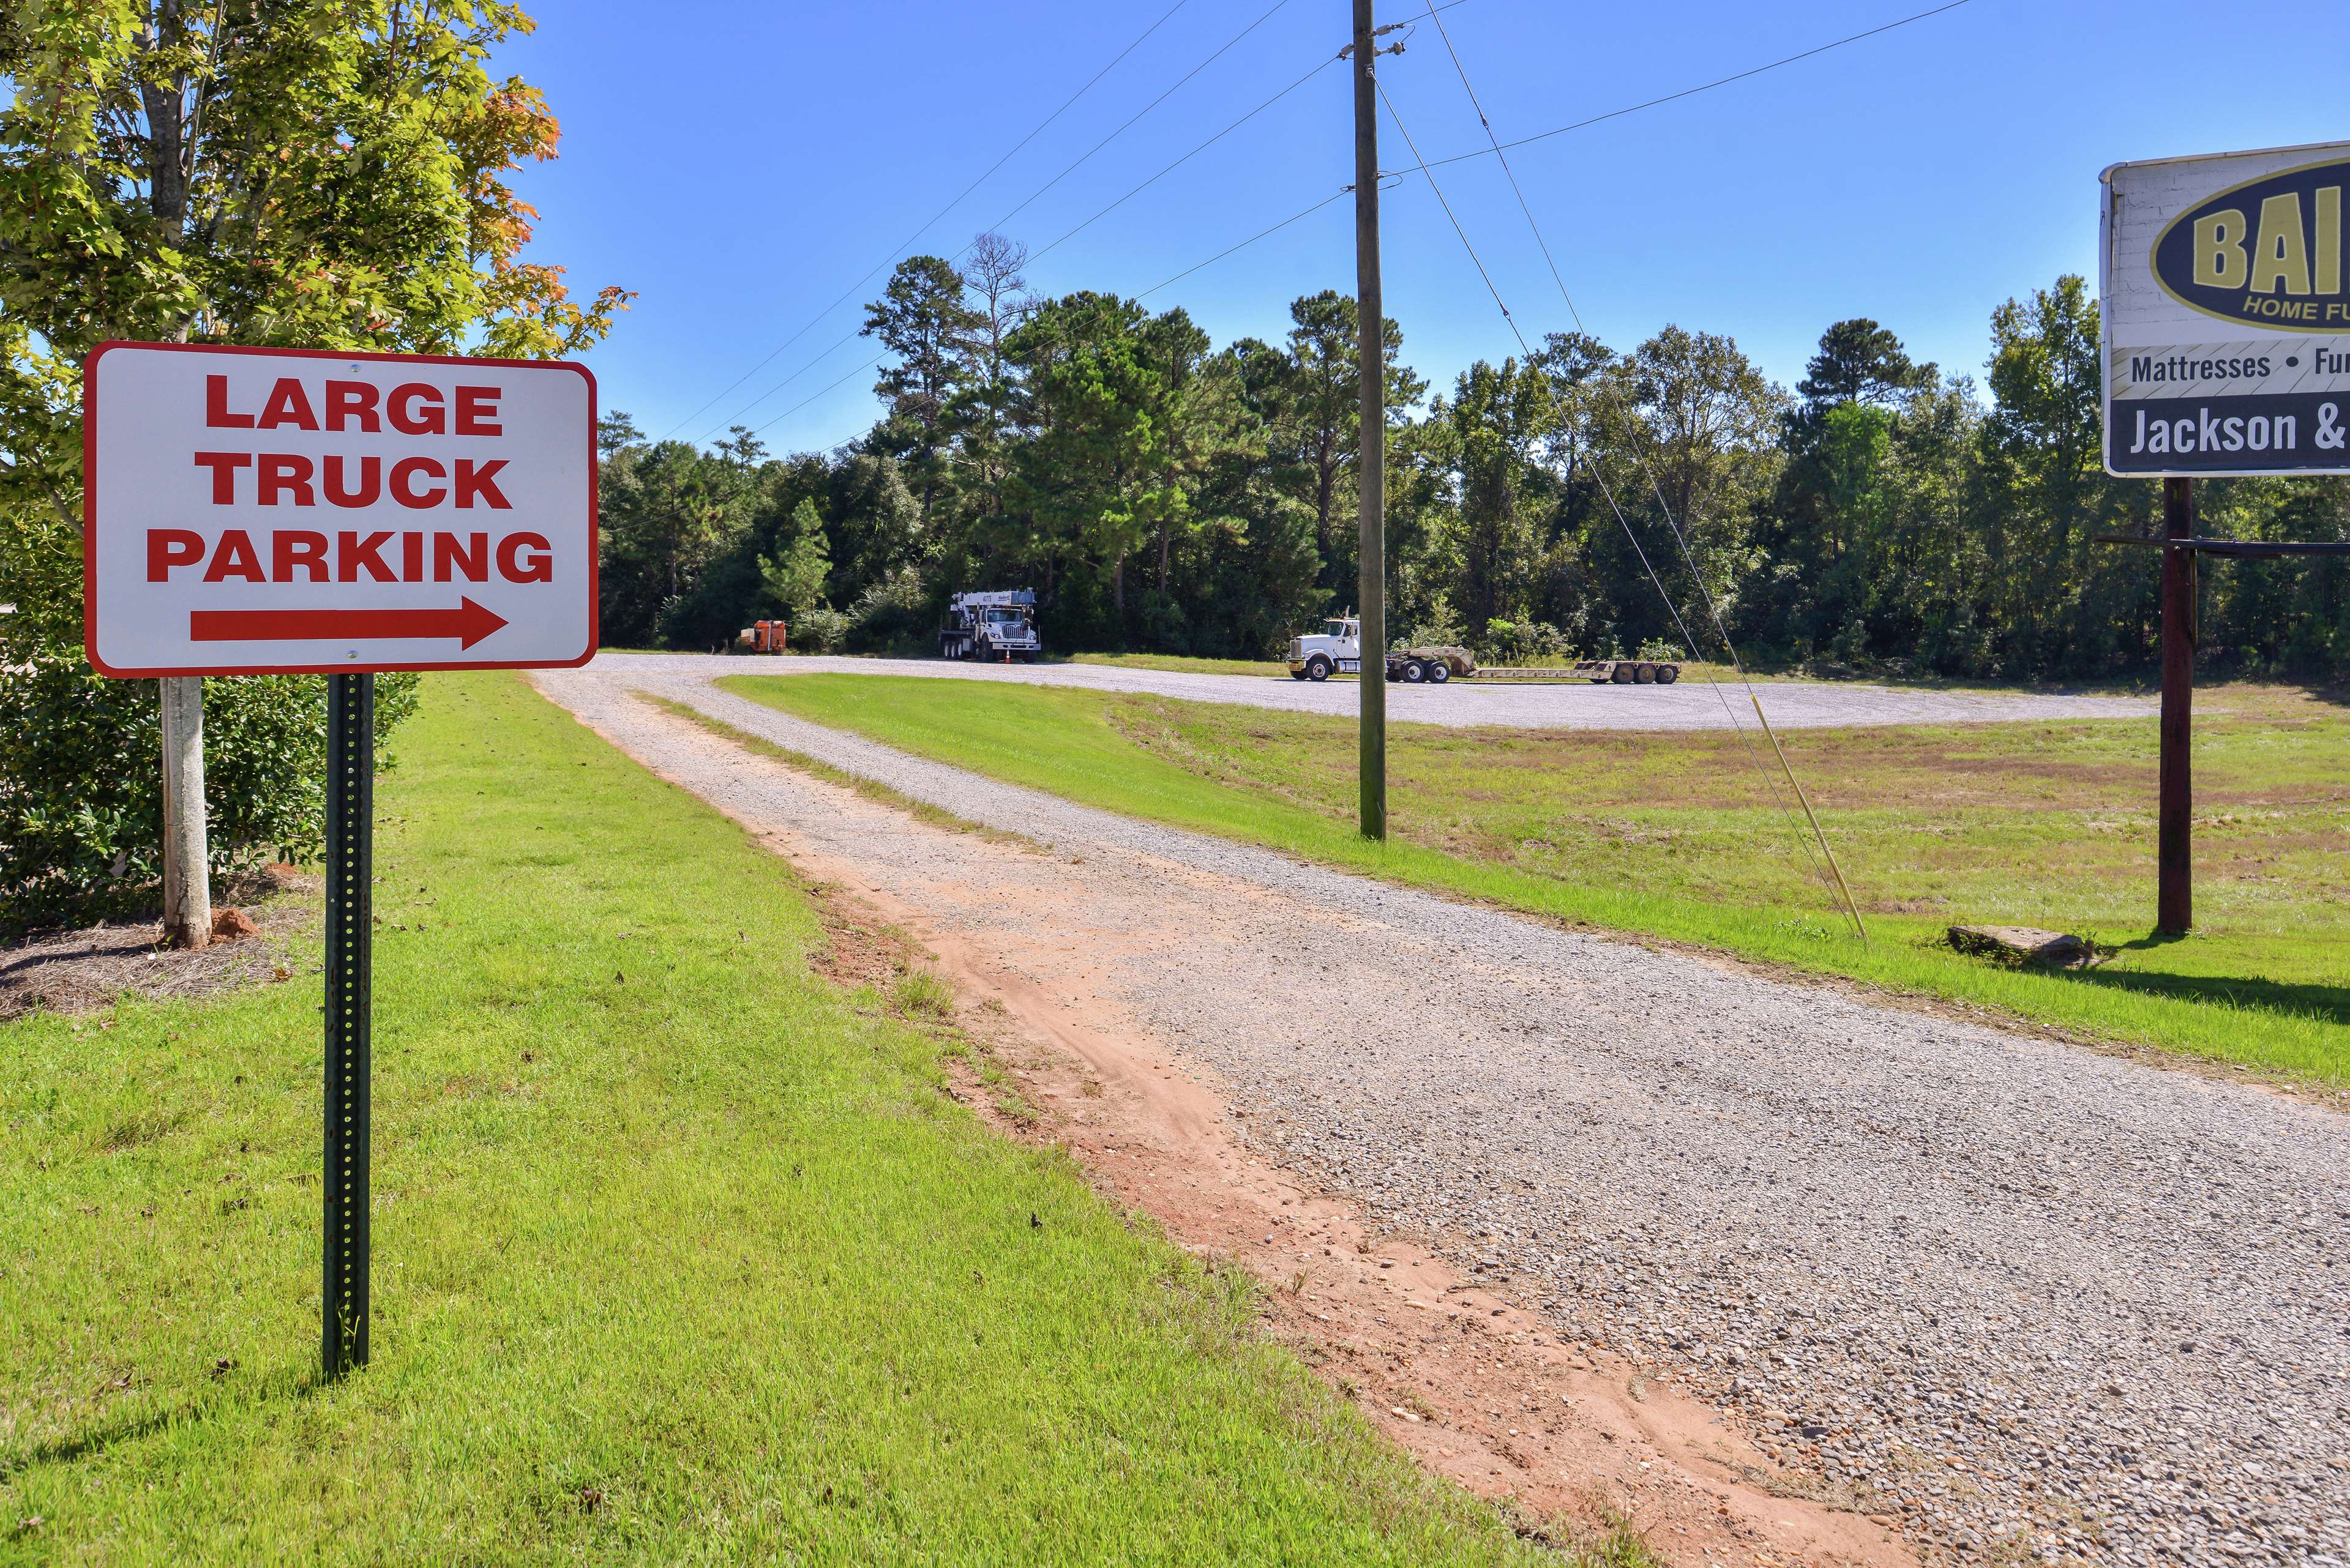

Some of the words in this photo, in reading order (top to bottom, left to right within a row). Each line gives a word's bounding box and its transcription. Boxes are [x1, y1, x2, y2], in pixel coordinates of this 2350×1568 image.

[2193, 185, 2350, 295] BAI
[2242, 295, 2319, 319] HOME
[2131, 356, 2271, 383] Mattresses
[206, 374, 503, 436] LARGE
[2130, 408, 2296, 454] Jackson
[2314, 401, 2346, 449] &
[193, 451, 514, 510] TRUCK
[146, 528, 553, 584] PARKING
